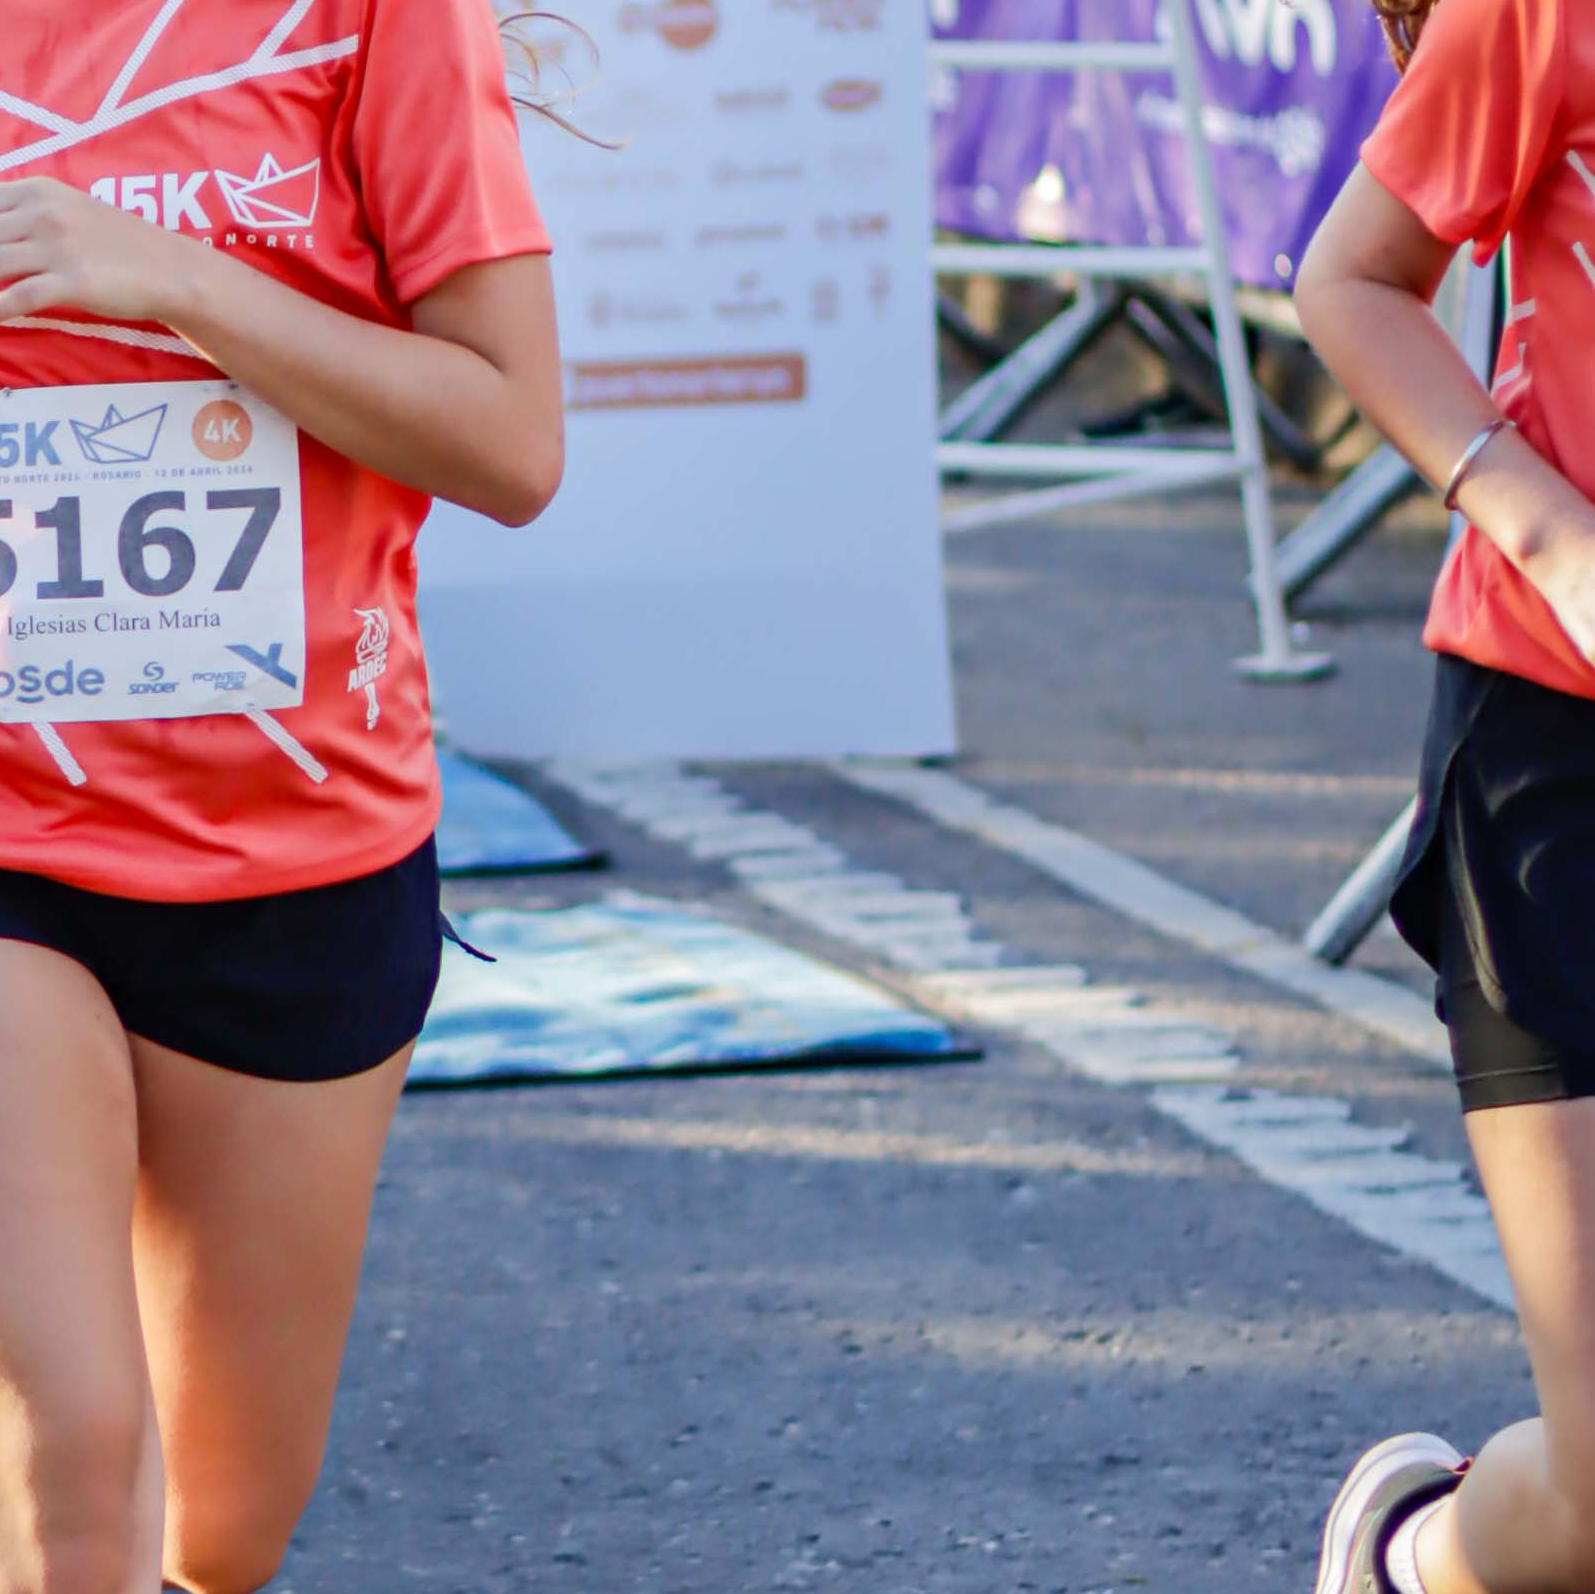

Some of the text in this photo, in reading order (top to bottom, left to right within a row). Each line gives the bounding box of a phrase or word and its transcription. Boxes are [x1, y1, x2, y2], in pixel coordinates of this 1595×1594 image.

[225, 233, 315, 249] NORTE
[202, 417, 243, 444] 4K
[14, 474, 49, 484] NORTE
[92, 470, 142, 480] ROSARIO
[171, 468, 185, 477] DE
[189, 466, 223, 476] ABRIL
[7, 614, 87, 641] Iglesias
[94, 612, 151, 633] Clara
[191, 671, 247, 683] POWER
